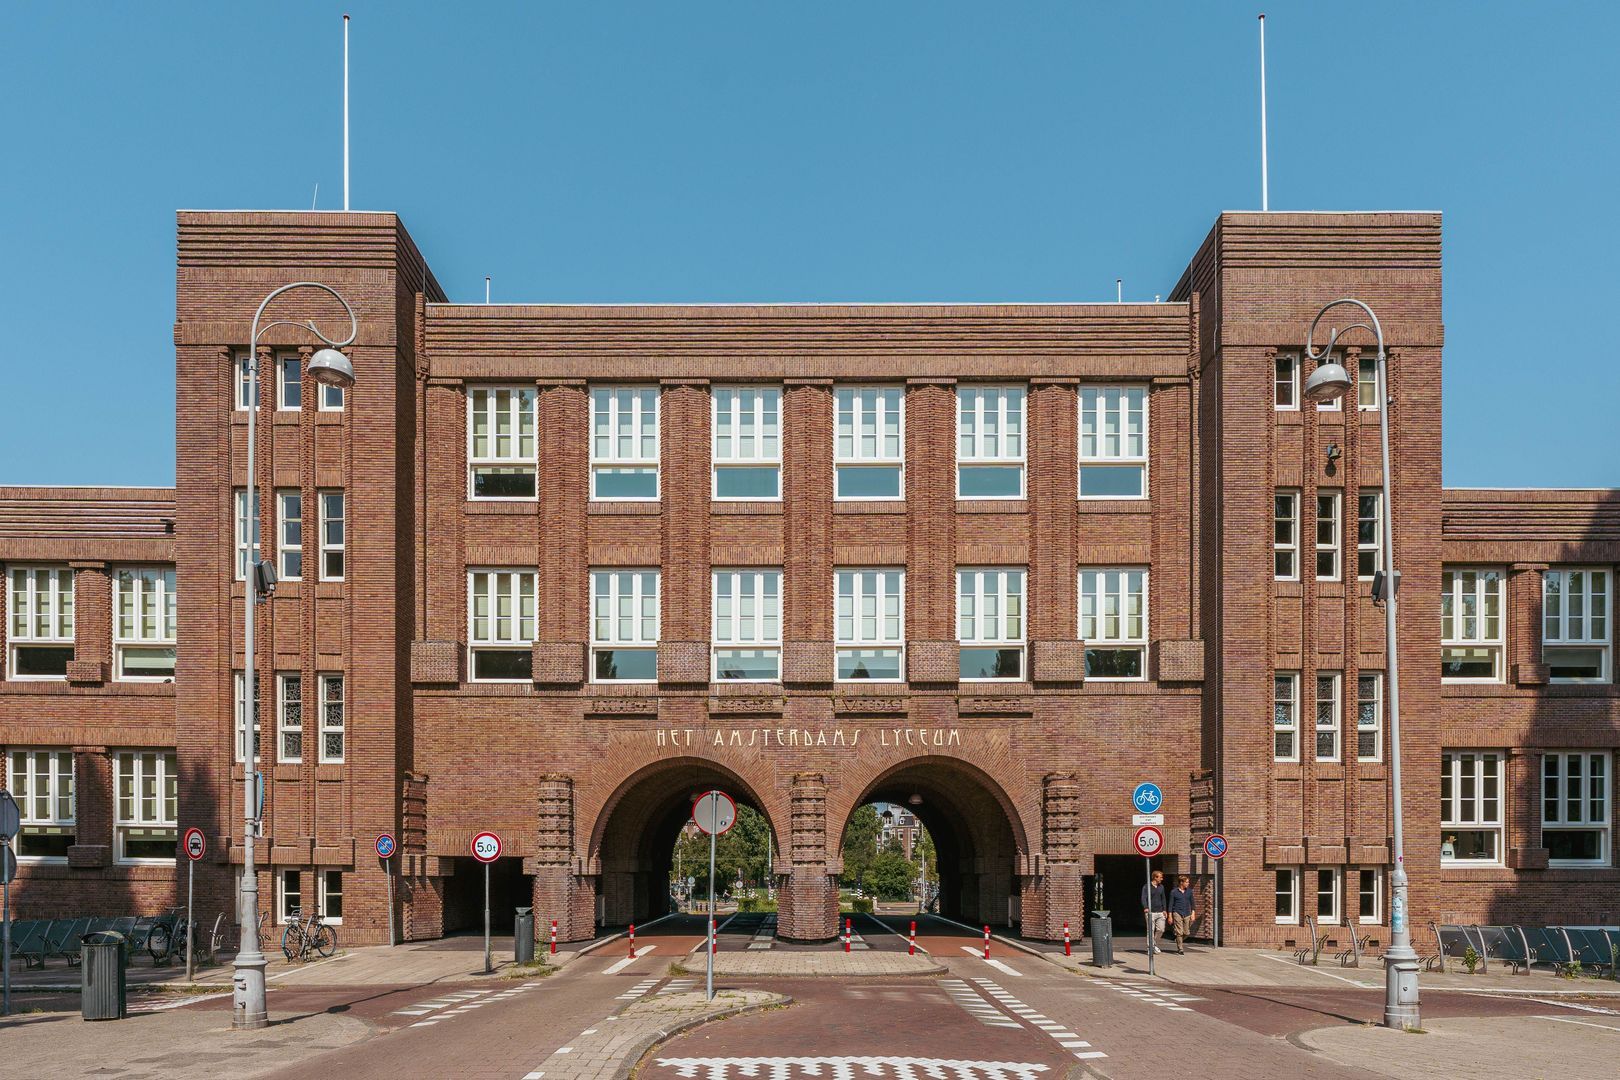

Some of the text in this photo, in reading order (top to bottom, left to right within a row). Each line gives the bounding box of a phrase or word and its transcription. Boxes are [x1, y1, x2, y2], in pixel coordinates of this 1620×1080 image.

[657, 729, 961, 746] HET AMSTERDAMS LYCEUM
